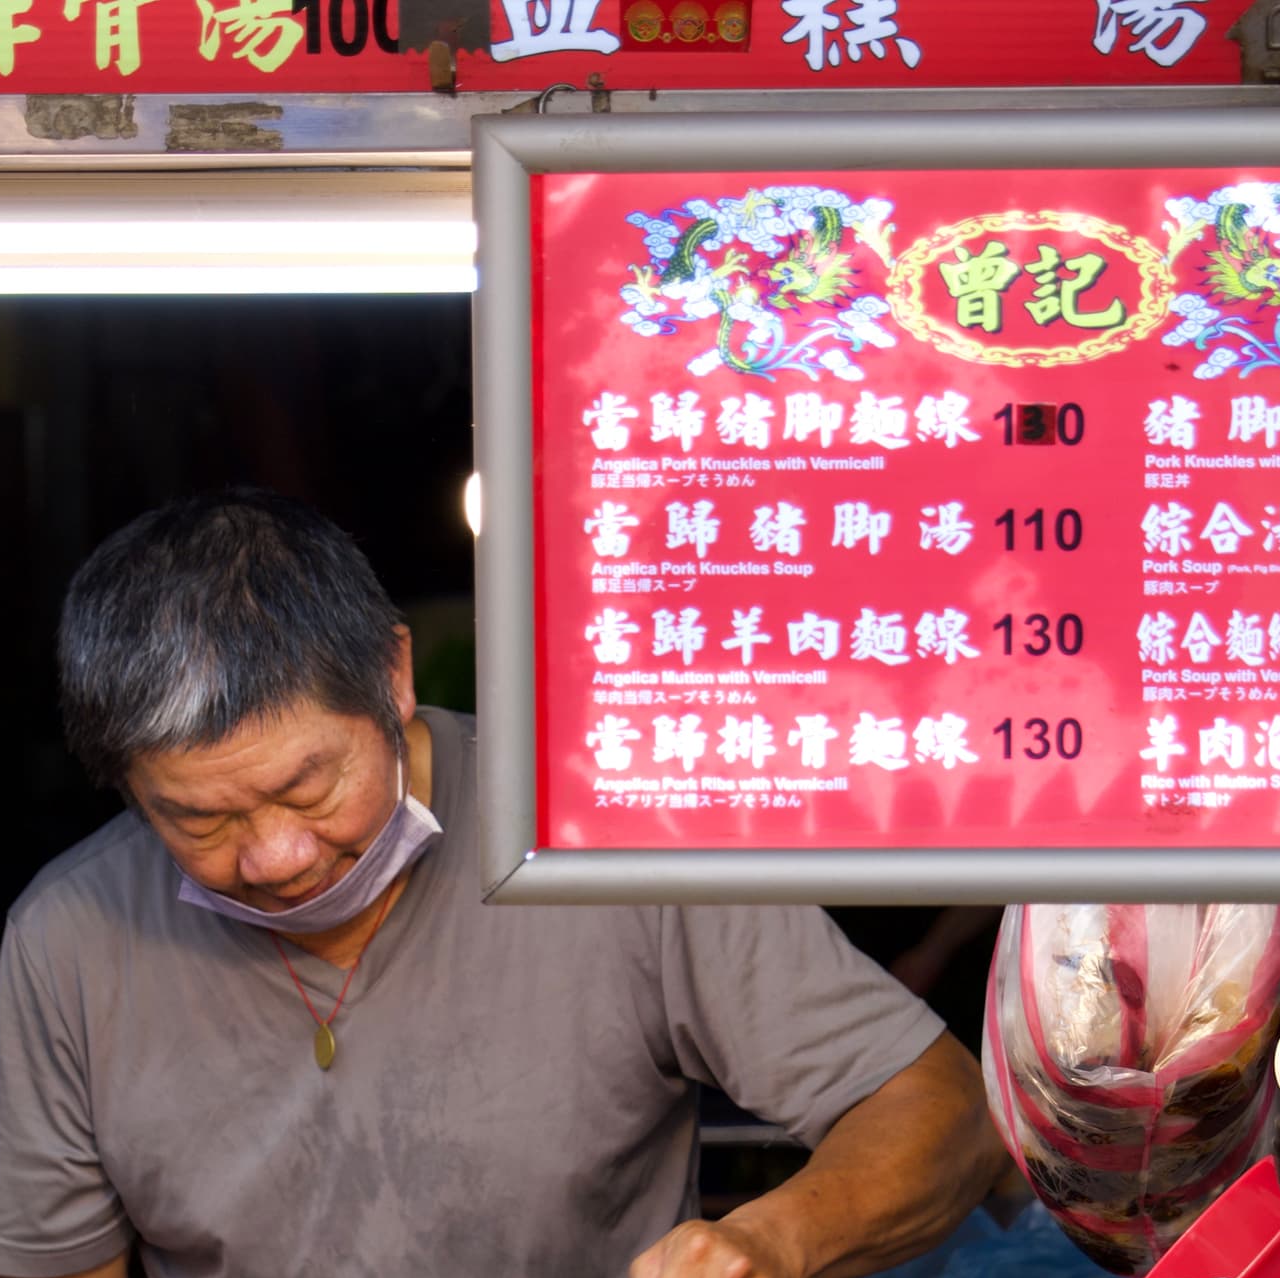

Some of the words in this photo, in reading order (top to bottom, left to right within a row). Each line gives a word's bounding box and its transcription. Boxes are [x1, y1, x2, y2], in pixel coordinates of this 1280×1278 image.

[938, 239, 1126, 333] 曾記
[592, 457, 658, 474] Angelica
[661, 457, 697, 471] Pork
[701, 457, 771, 471] Knuckles
[774, 457, 806, 471] with
[810, 457, 884, 471] Vermicelli
[1144, 454, 1181, 468] Pork
[1184, 454, 1255, 468] Knuckles
[1144, 473, 1190, 489] 豚足丼
[994, 509, 1083, 552] 110
[591, 561, 657, 579] Angelica
[661, 562, 696, 575] Pork
[700, 562, 769, 575] Knuckles
[774, 561, 814, 577] Soup
[1142, 559, 1179, 574] Pork
[1182, 559, 1223, 576] Soup
[1143, 580, 1220, 596] 豚肉スープ
[584, 607, 981, 666] 當歸羊肉麵線
[993, 614, 1084, 656] 130
[593, 671, 659, 688] Angelica
[661, 671, 715, 685] Mutton
[717, 671, 750, 684] with
[753, 671, 827, 684] Vermicelli
[1142, 669, 1177, 683] Pork
[1181, 669, 1221, 685] Soup
[1224, 669, 1257, 682] with
[585, 712, 980, 772] 當歸排骨麵線
[993, 718, 1083, 760] 130
[594, 777, 660, 794] Angelica
[662, 776, 698, 791] Pork
[701, 777, 736, 791] Ribs
[738, 777, 771, 791] with
[774, 777, 848, 791] Vermicelli
[1141, 775, 1174, 789] Rice
[1178, 775, 1211, 789] with
[1213, 775, 1267, 789] Mutton
